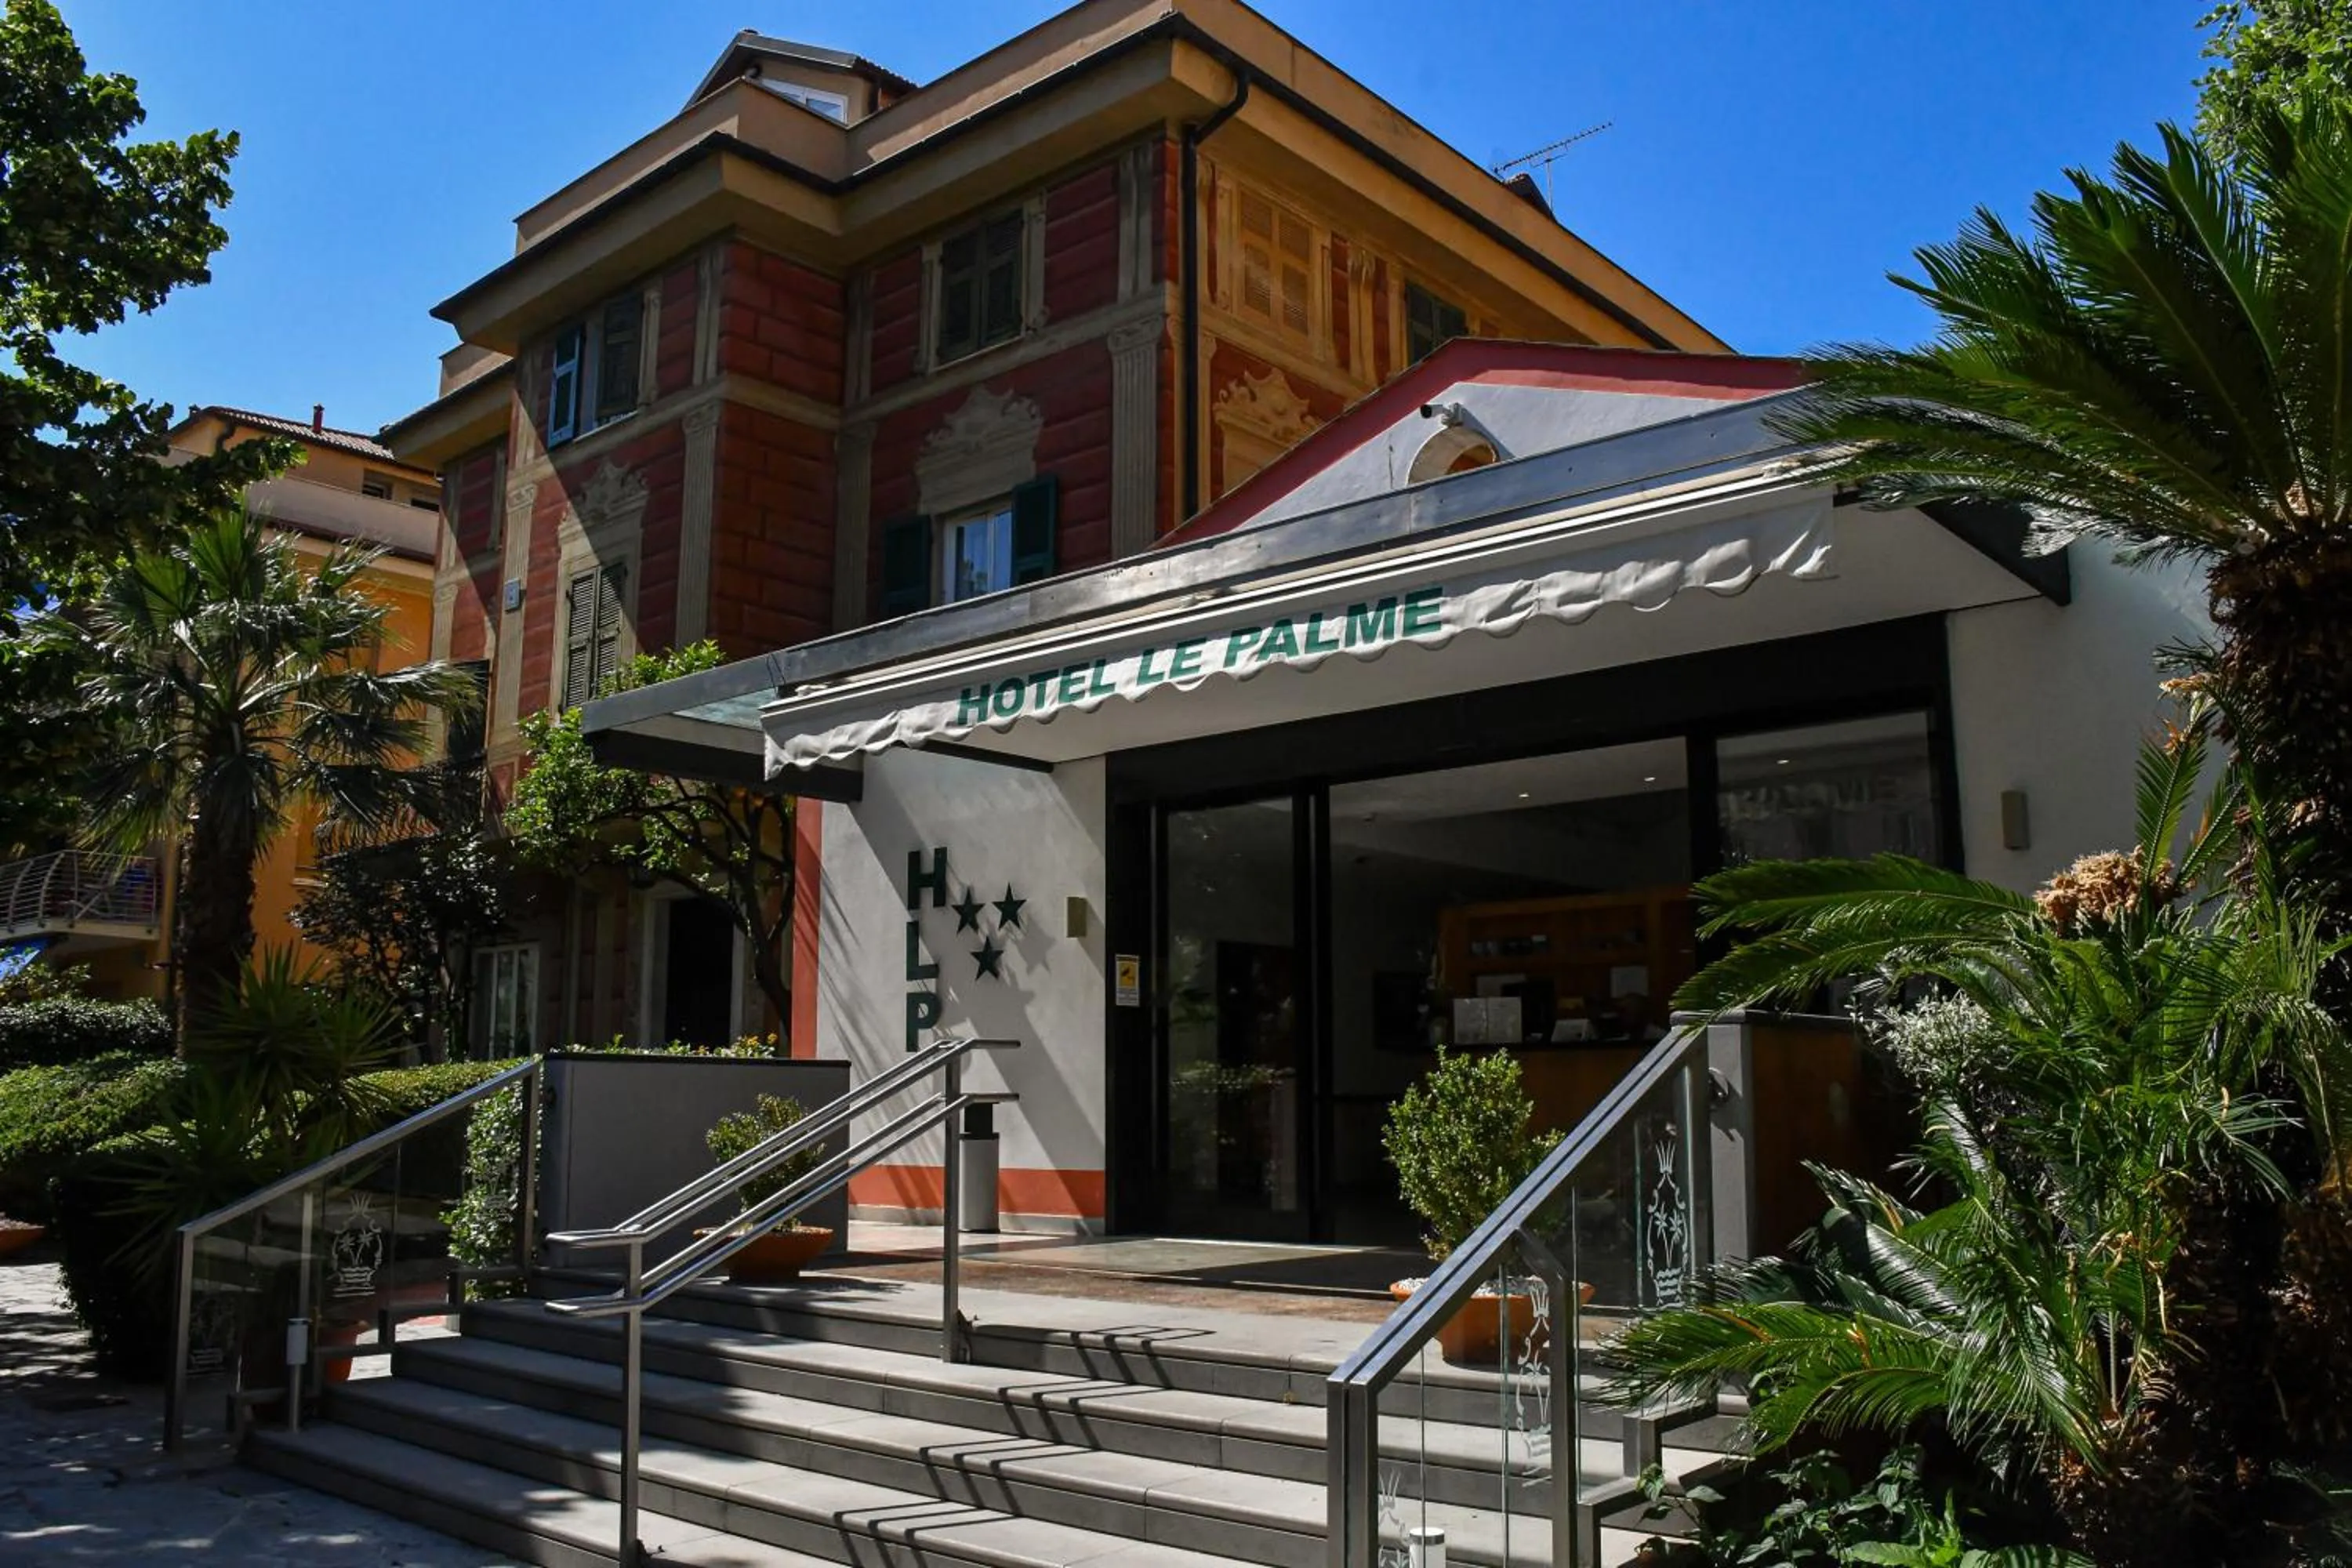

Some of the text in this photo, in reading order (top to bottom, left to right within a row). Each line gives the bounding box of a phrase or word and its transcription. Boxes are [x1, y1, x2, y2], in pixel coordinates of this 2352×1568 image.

[957, 586, 1443, 725] HOTEL LE PALME
